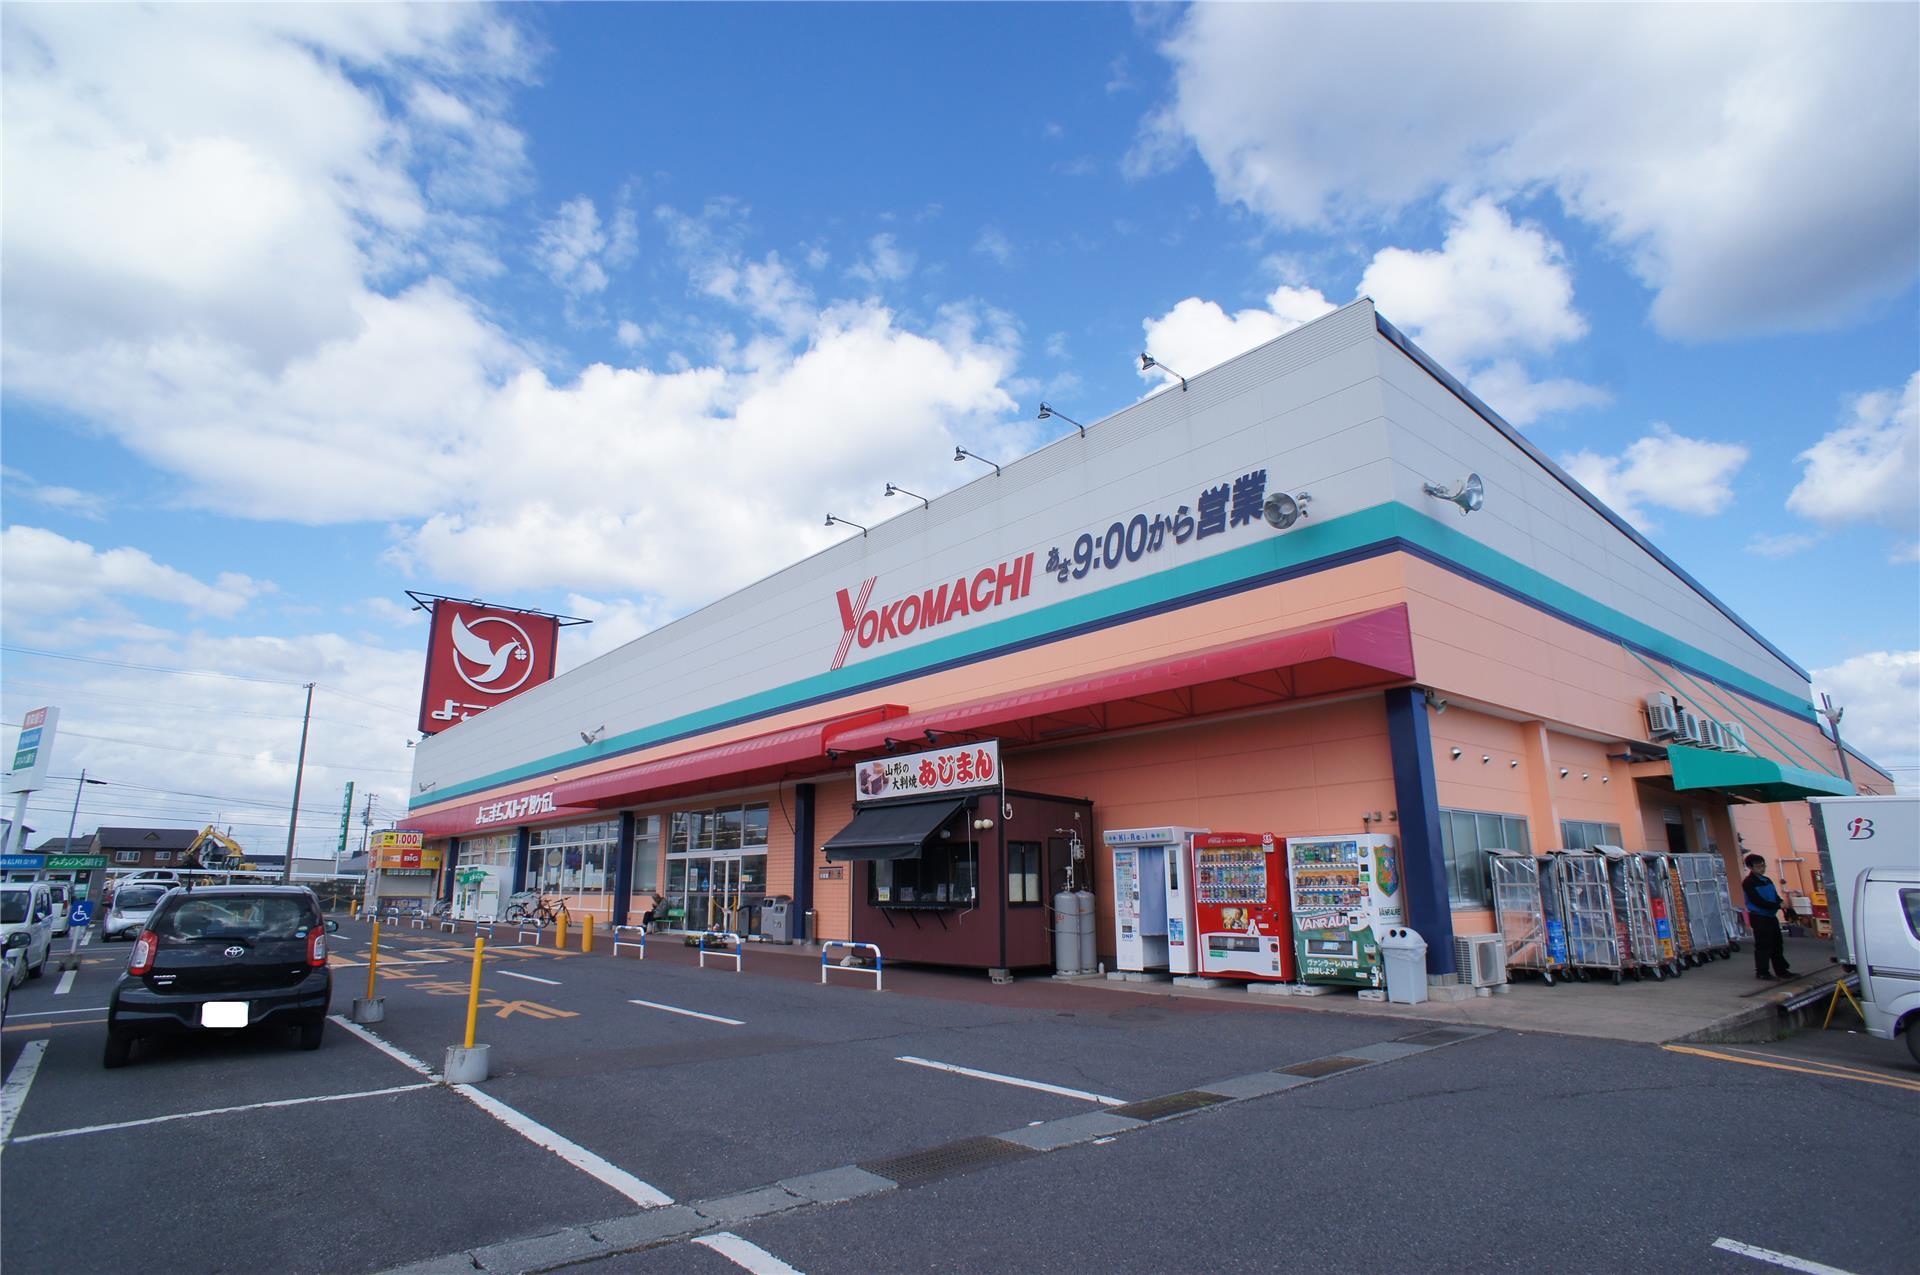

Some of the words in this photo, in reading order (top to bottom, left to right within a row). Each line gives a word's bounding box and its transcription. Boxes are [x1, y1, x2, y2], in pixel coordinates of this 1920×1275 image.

[831, 552, 1036, 672] YOKOMACHI
[885, 762, 910, 777] 山形の
[892, 774, 918, 791] 大判焼
[918, 749, 995, 789] あじまん
